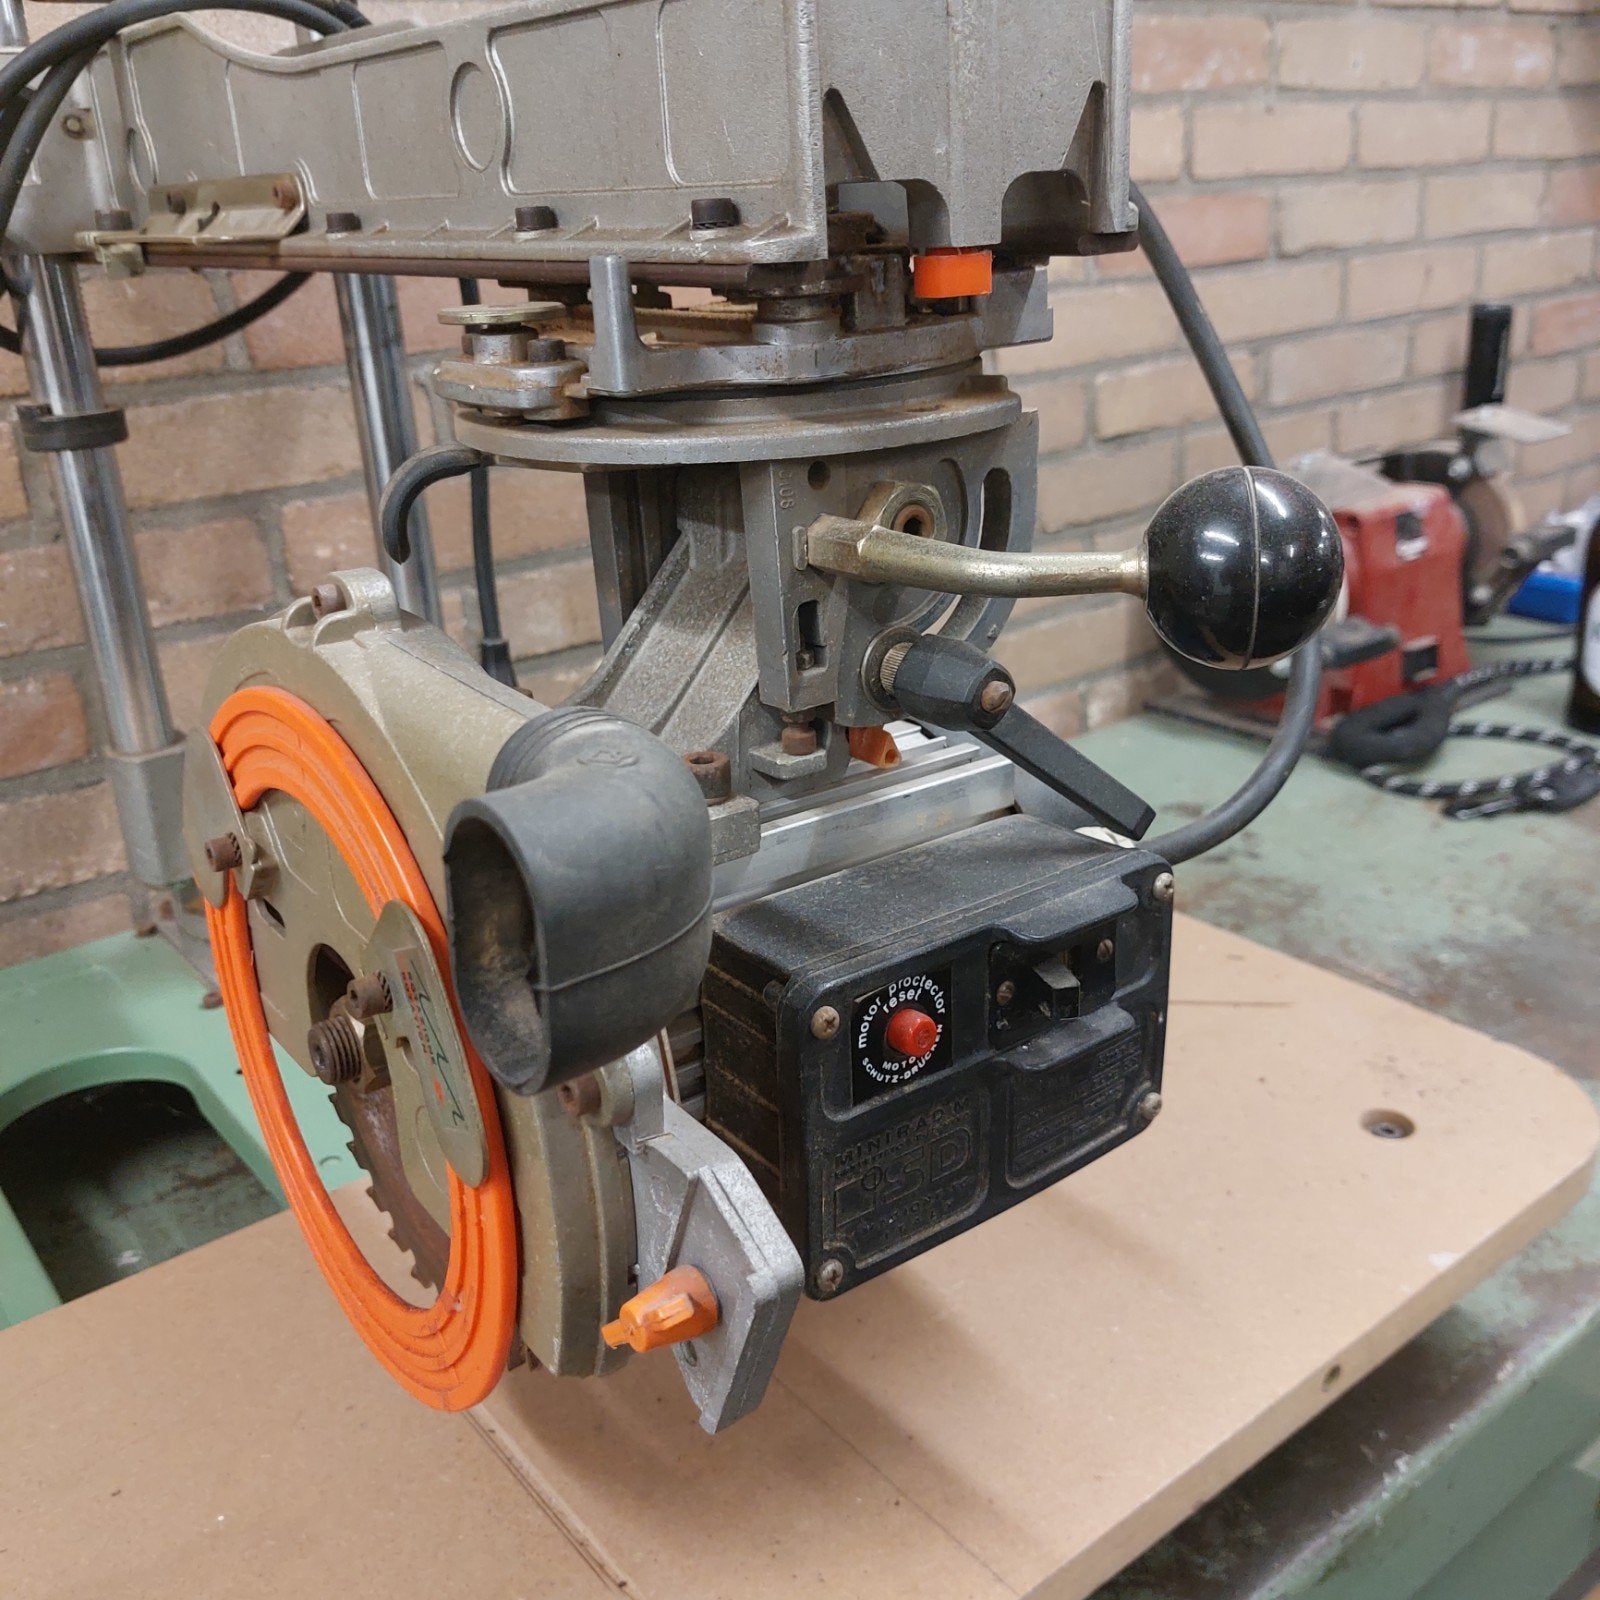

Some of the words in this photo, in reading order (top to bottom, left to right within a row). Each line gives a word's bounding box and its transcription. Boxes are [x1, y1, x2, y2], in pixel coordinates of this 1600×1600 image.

[858, 996, 882, 1049] motor
[888, 974, 945, 1014] proctector
[882, 988, 922, 1014] reset
[882, 1056, 916, 1071] MOTO
